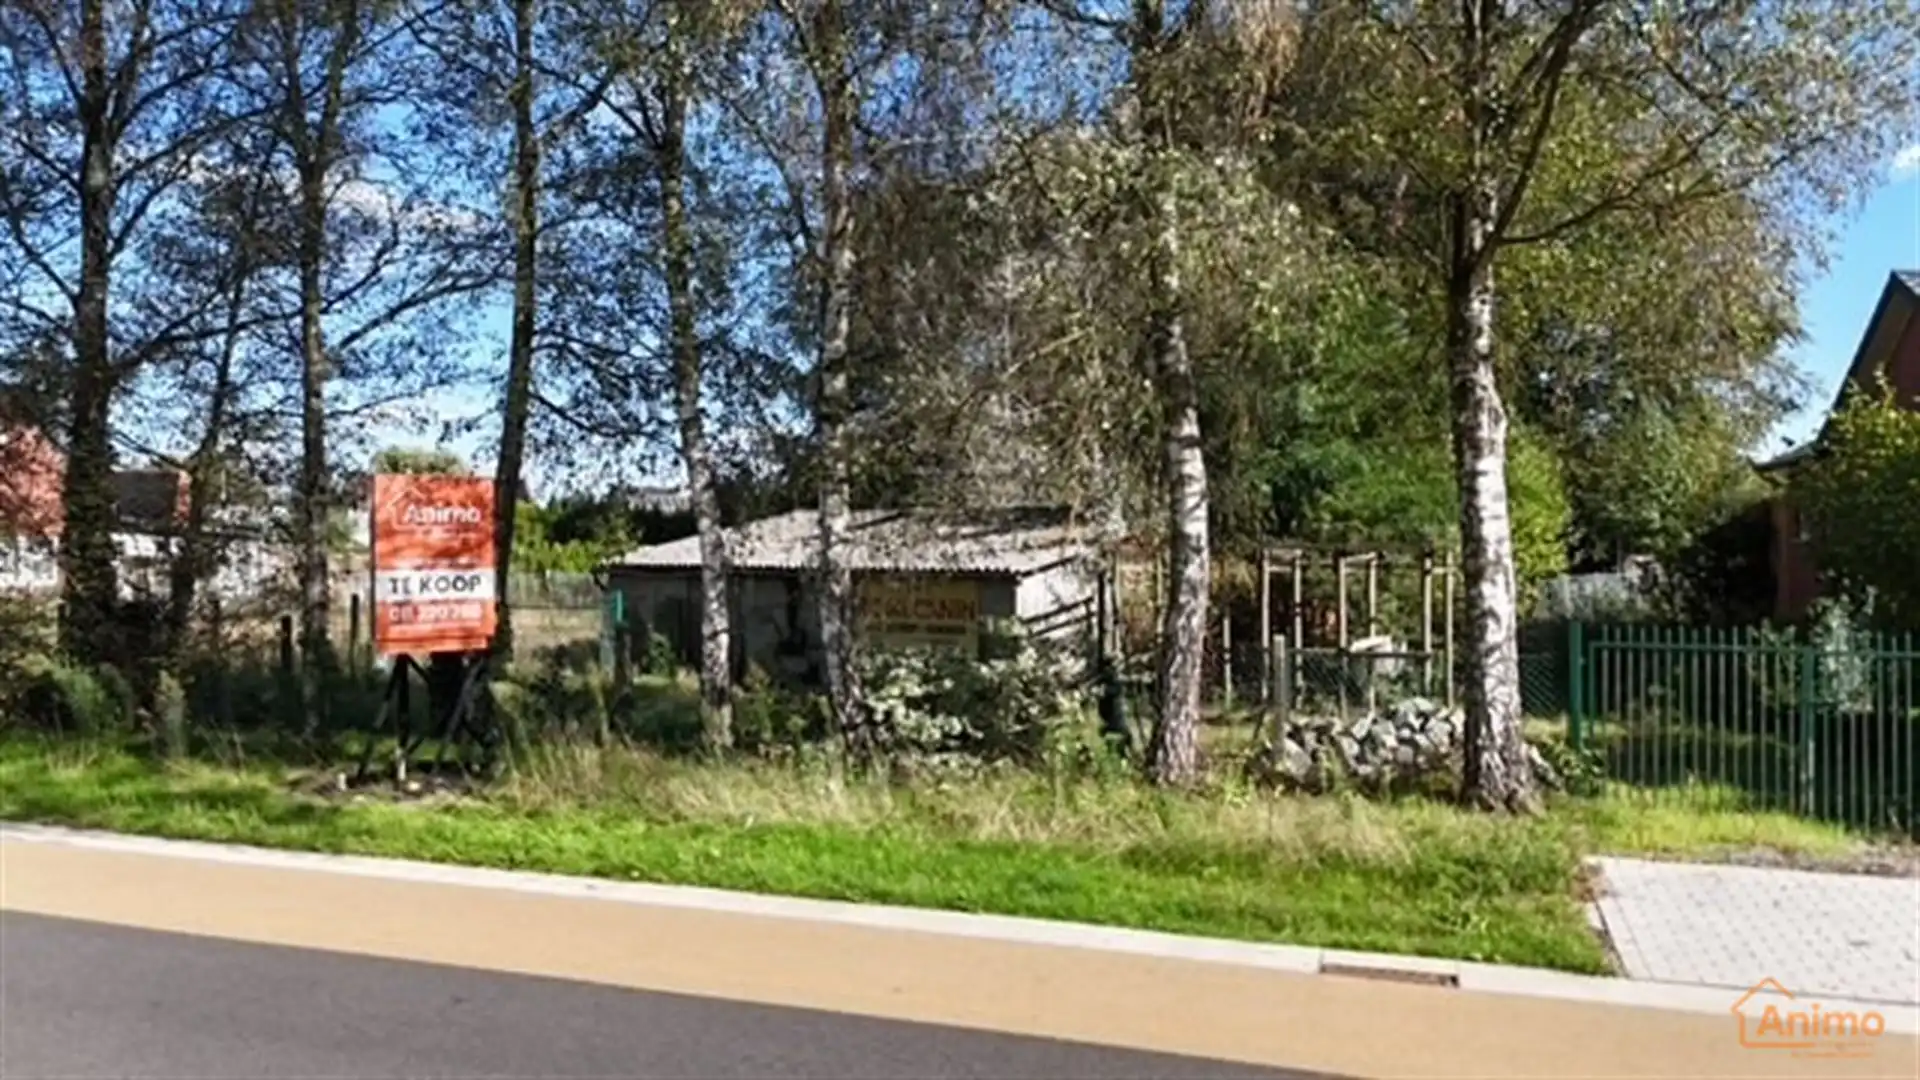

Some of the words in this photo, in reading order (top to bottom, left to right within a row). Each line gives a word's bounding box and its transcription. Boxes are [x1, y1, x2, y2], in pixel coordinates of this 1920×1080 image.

[404, 503, 482, 524] Animo
[388, 577, 411, 595] TE
[419, 574, 481, 593] KOOP
